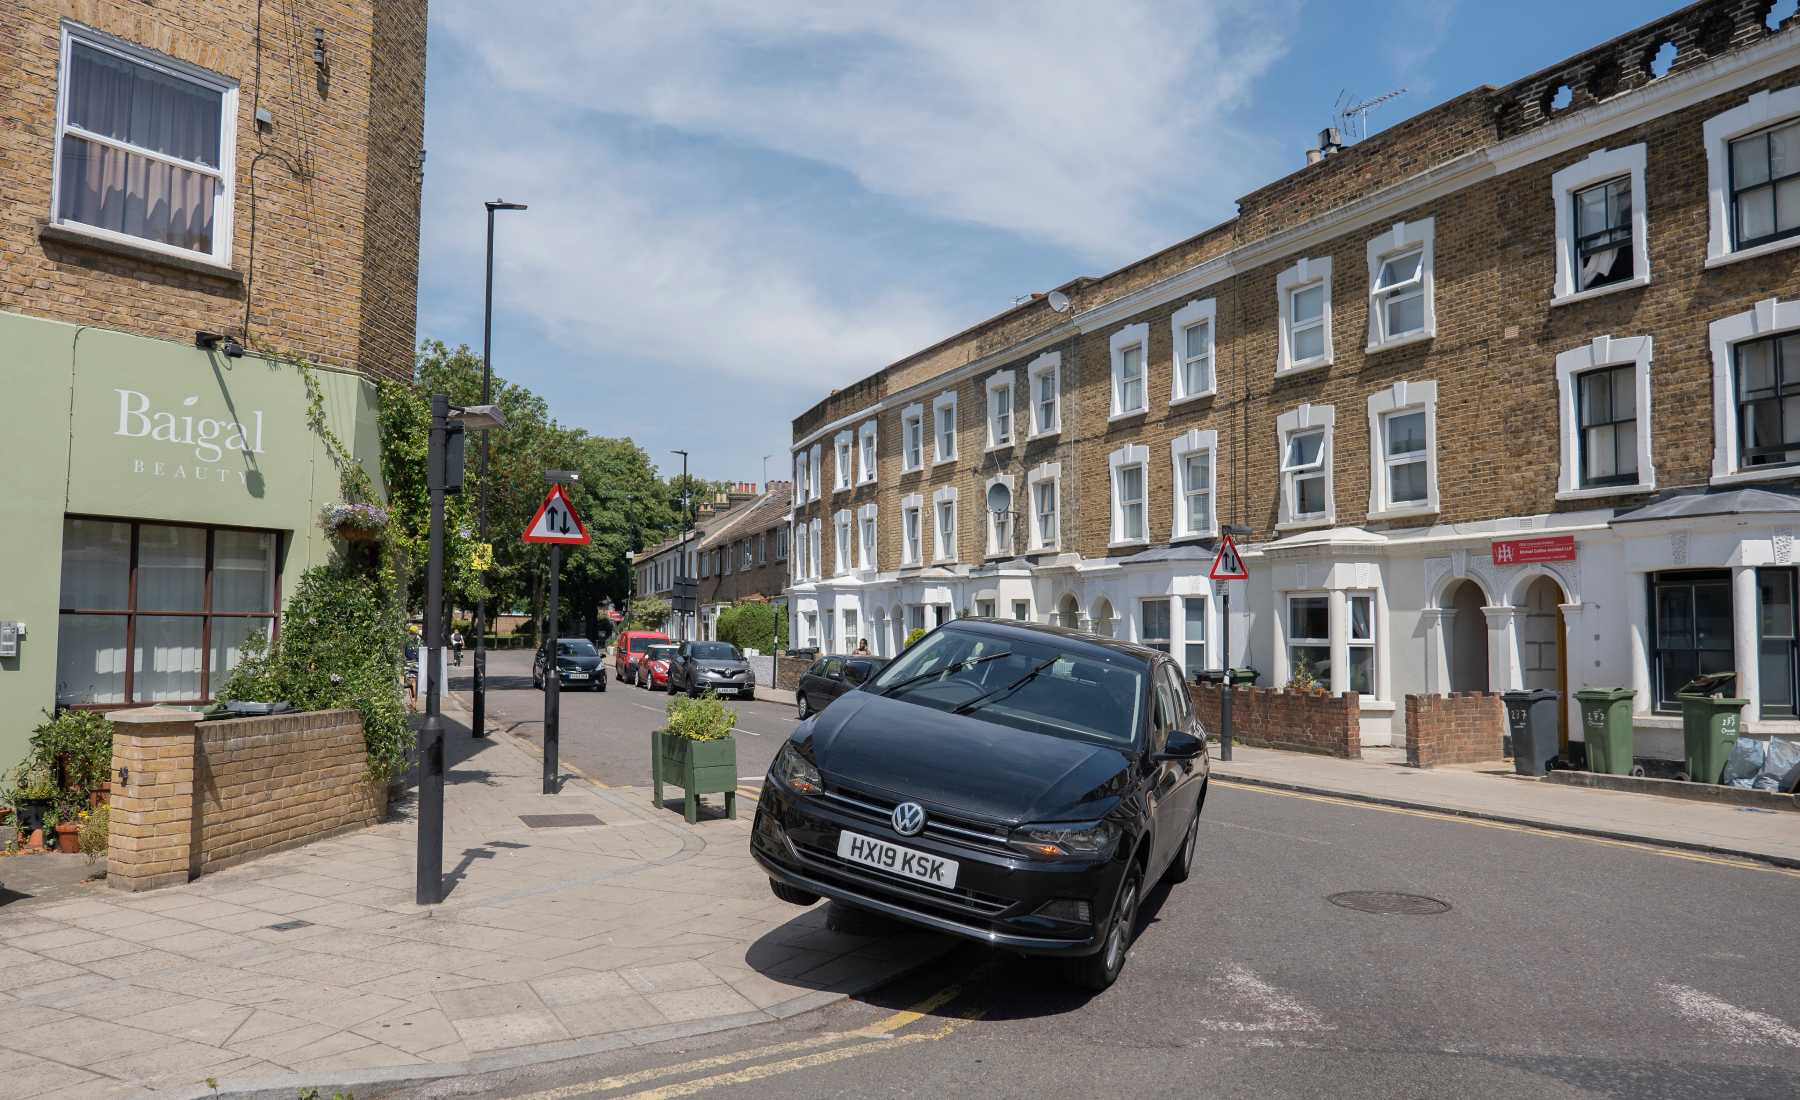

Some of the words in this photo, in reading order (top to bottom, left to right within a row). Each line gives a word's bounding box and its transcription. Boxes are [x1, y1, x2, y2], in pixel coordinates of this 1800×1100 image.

[113, 388, 265, 463] Baigal
[850, 837, 897, 868] HX19
[901, 851, 945, 882] KSK
